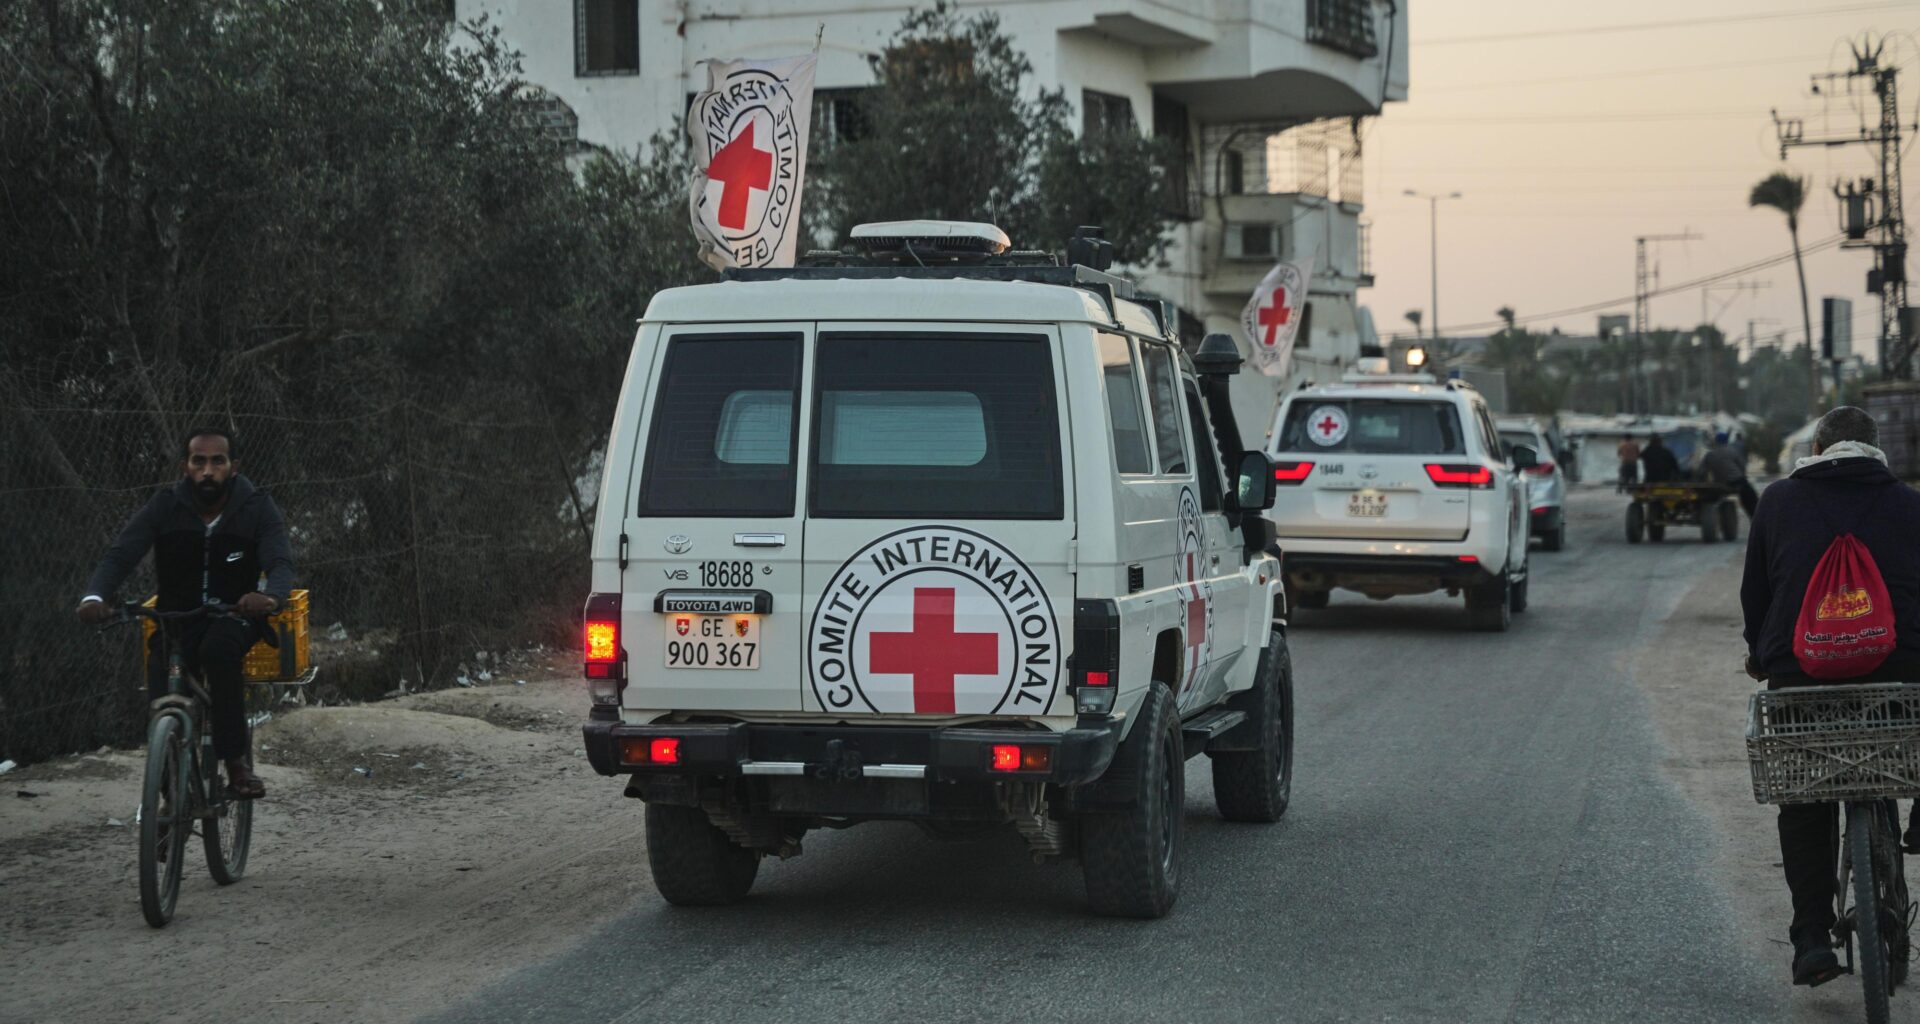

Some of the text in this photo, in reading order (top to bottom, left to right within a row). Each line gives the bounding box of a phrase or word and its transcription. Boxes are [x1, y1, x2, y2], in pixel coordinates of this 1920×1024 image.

[664, 569, 689, 580] V8
[698, 561, 754, 587] 18688
[668, 601, 753, 611] TOYOTA 4WD
[701, 619, 723, 637] GE
[818, 572, 870, 708] COMITE
[870, 536, 1051, 706] INTERNATIONAL
[668, 641, 757, 667] 900 367
